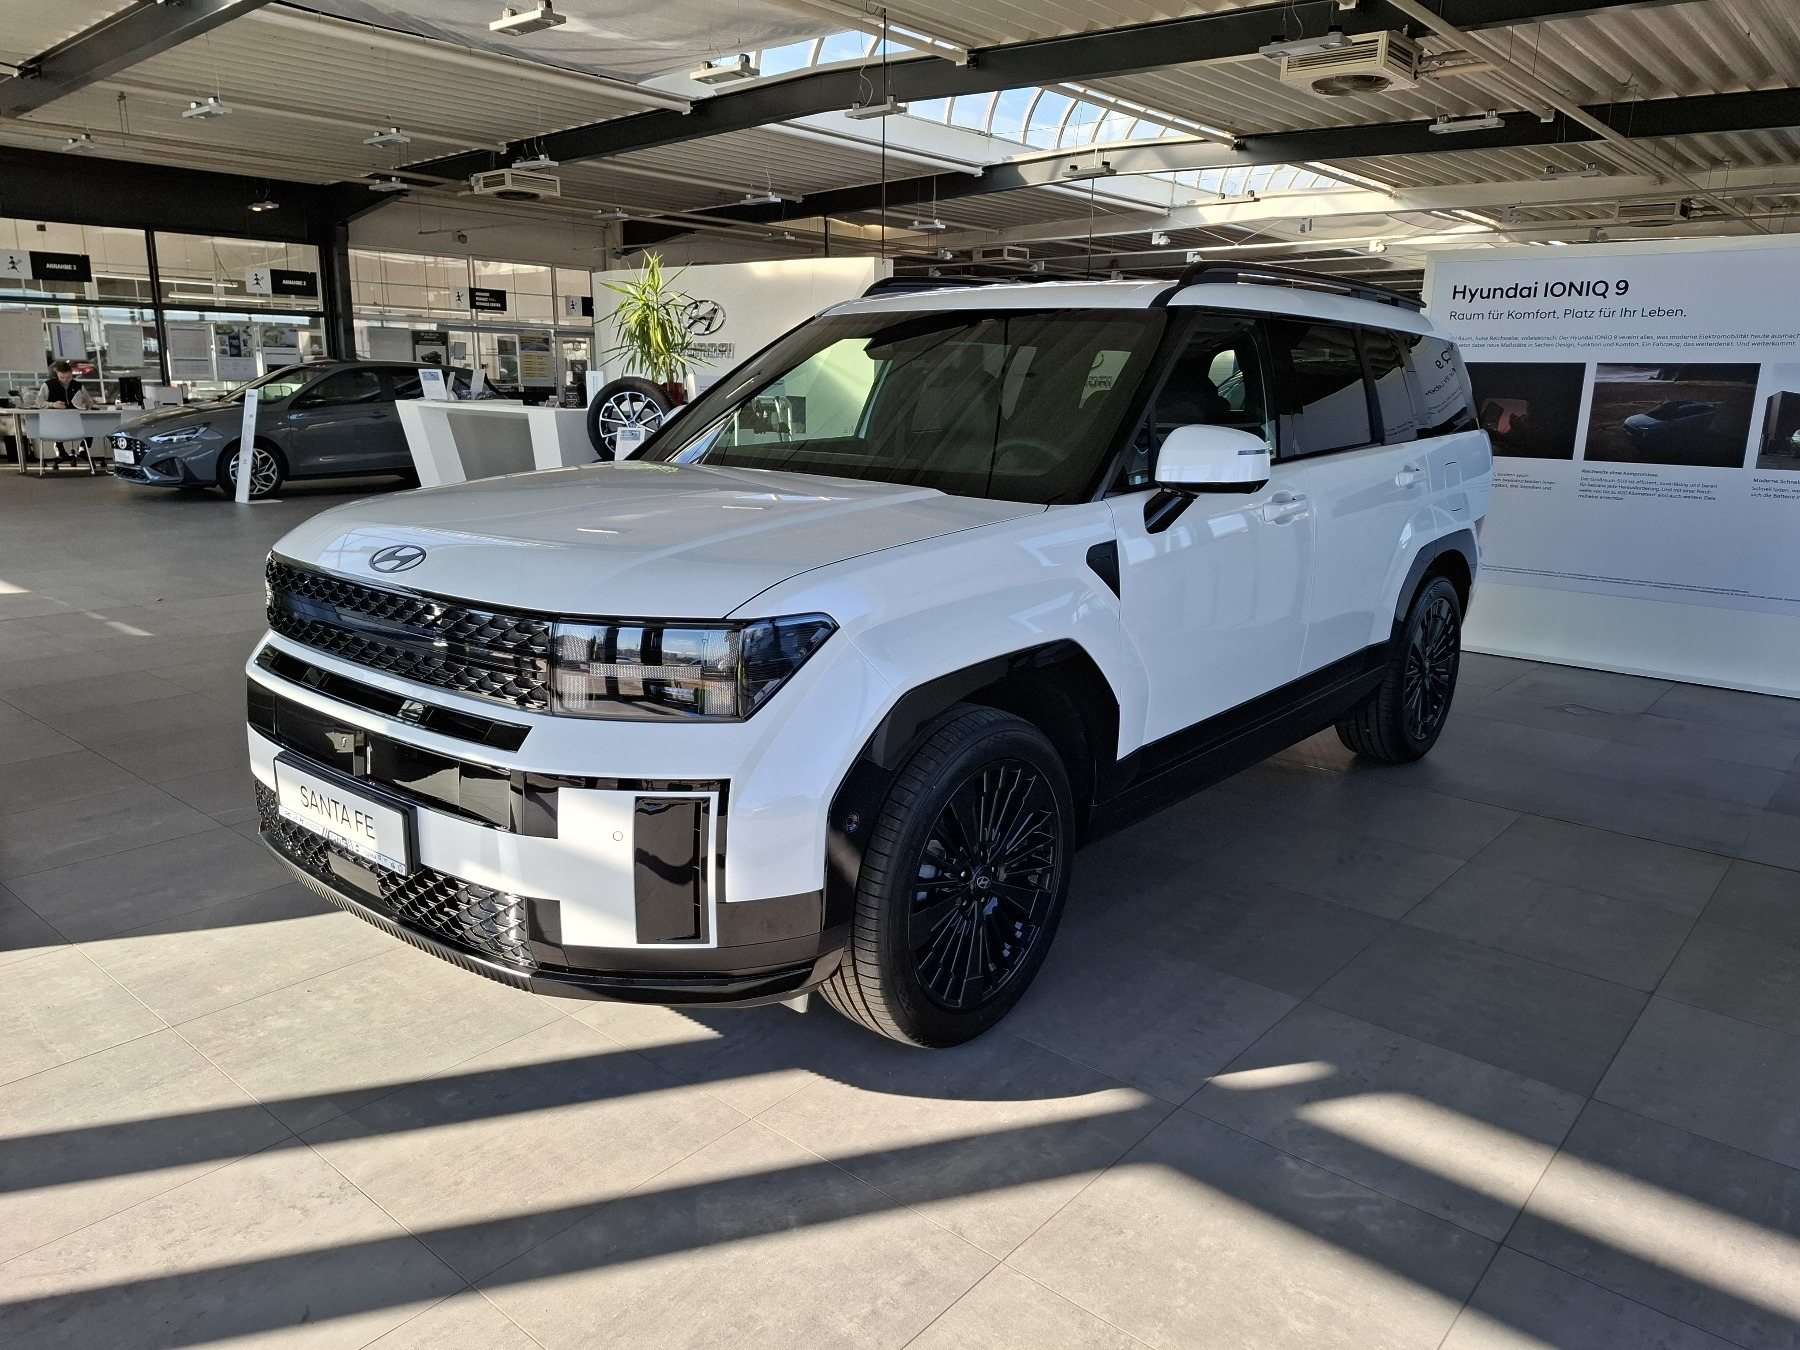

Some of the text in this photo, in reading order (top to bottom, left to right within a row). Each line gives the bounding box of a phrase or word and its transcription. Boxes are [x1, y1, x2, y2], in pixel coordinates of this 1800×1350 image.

[1452, 279, 1630, 303] Hyundai IONIQ 9
[1449, 306, 1688, 321] Raum für Komfort. Platz für Ihr Leben.
[300, 785, 376, 840] SANTA FE
